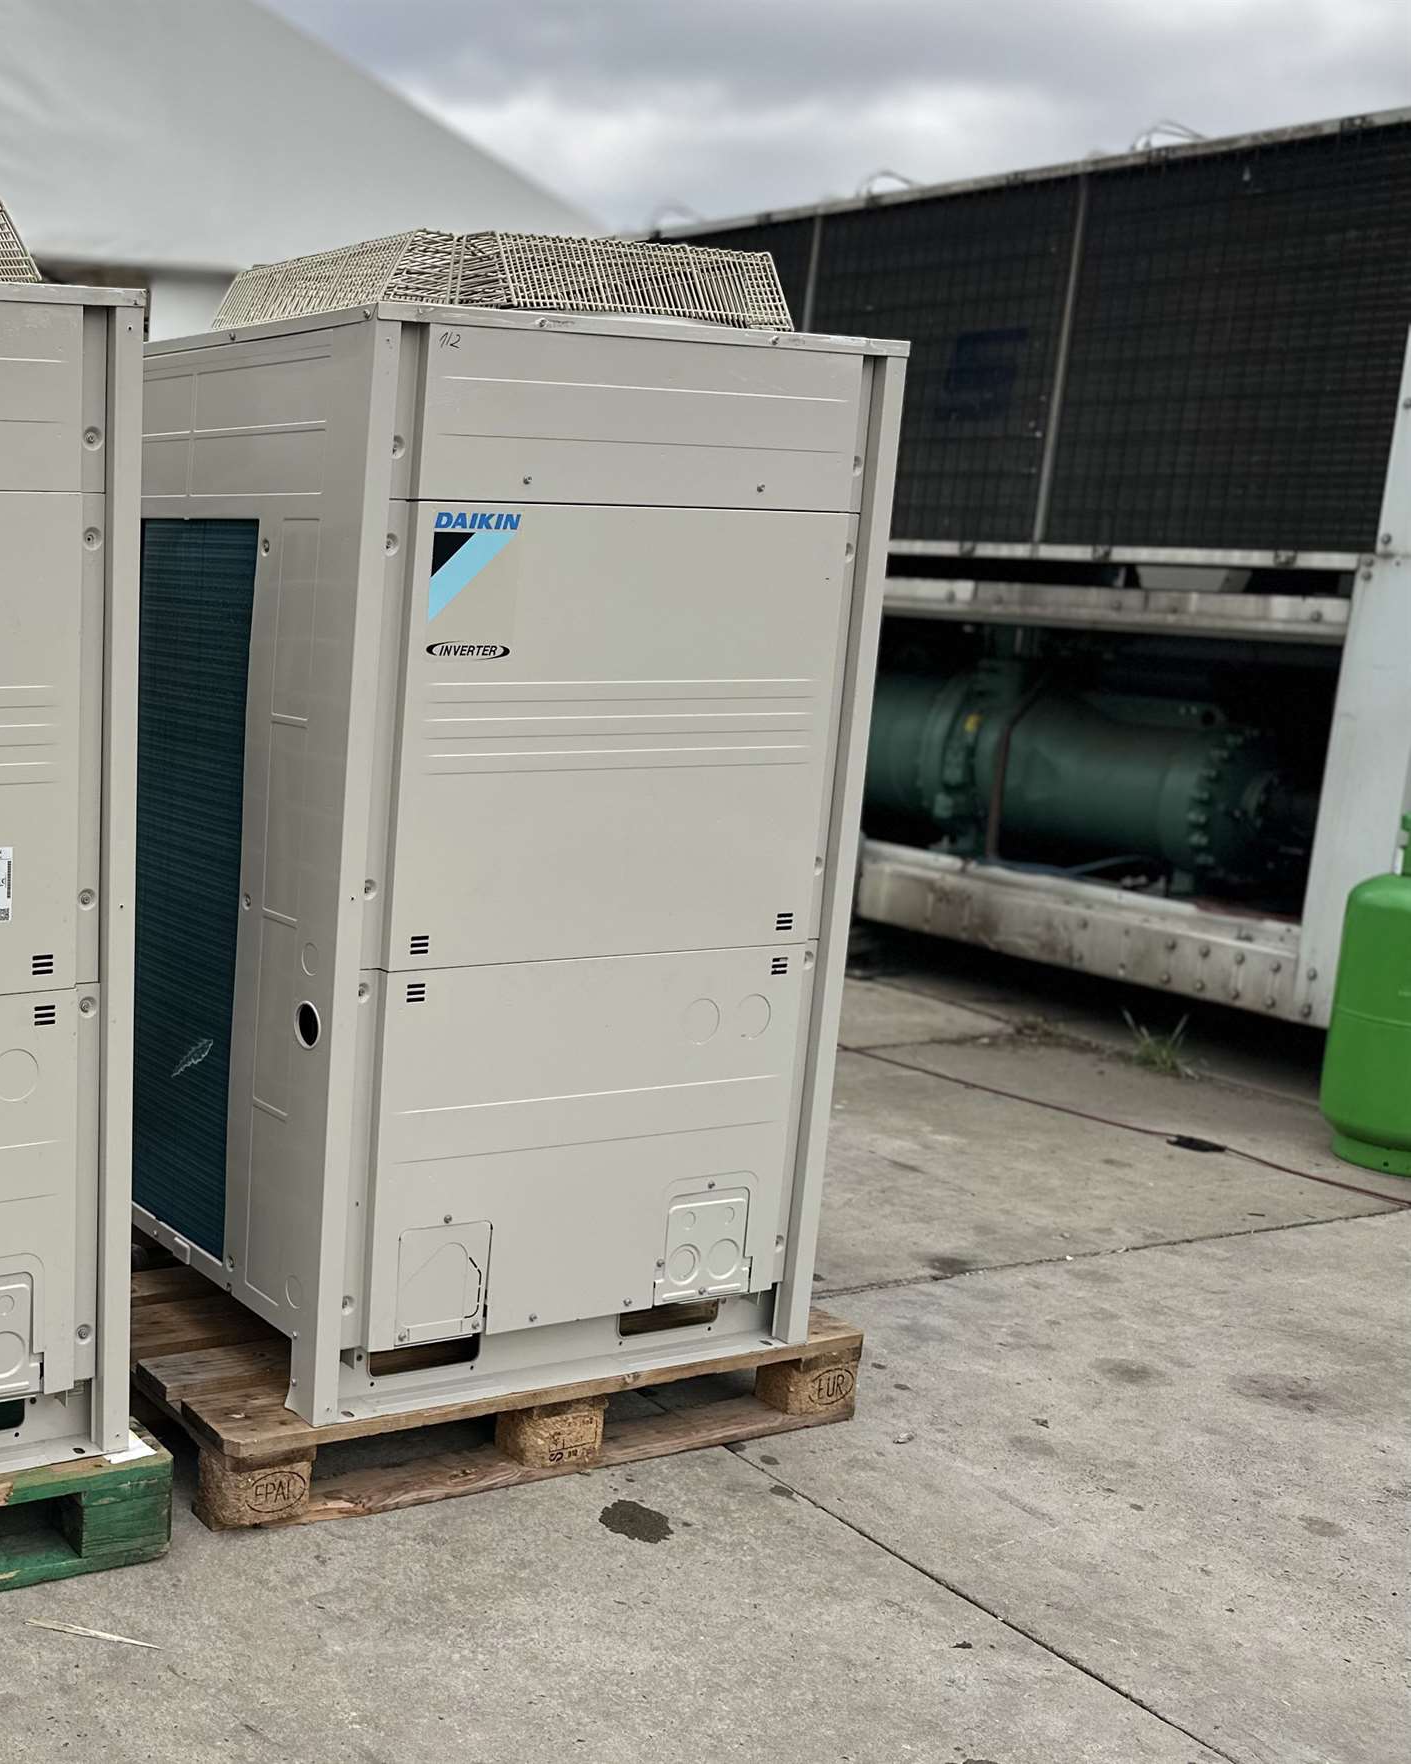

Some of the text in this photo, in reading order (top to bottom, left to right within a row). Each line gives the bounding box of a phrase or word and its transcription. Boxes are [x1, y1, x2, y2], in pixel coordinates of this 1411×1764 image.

[434, 511, 521, 530] DAIKIN
[439, 644, 498, 657] INVERTER
[816, 1373, 845, 1400] EUR
